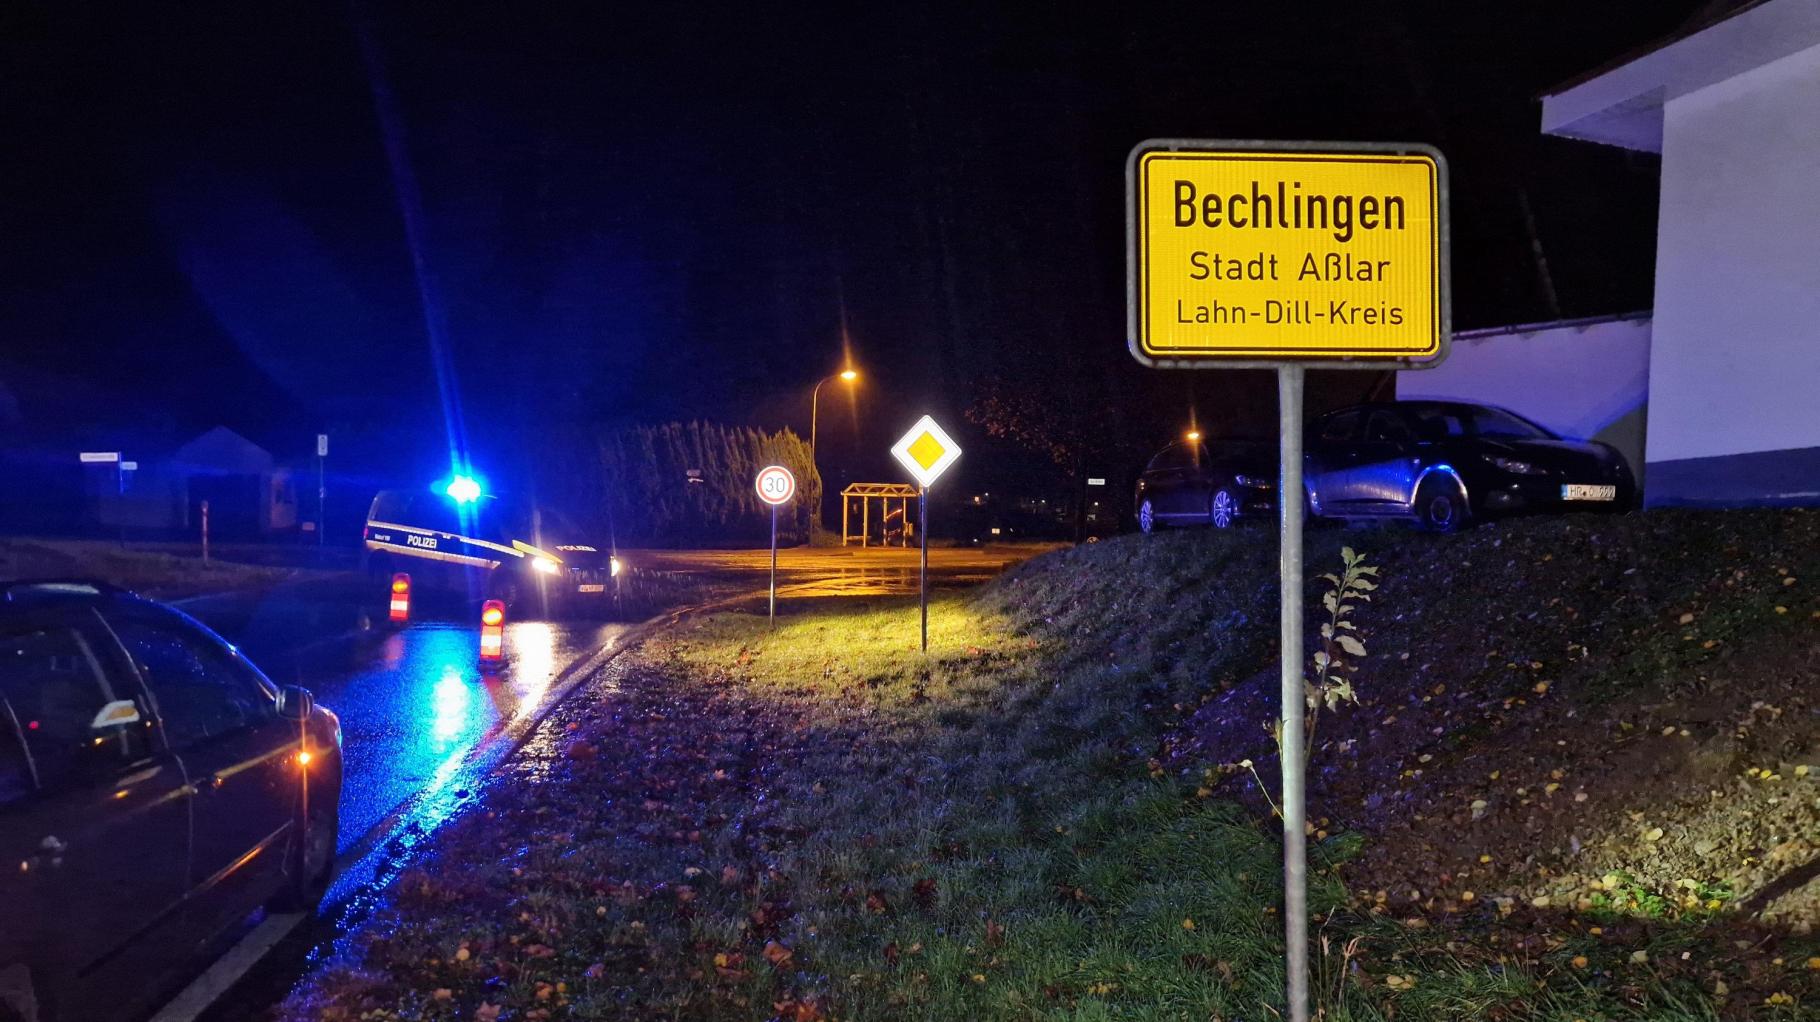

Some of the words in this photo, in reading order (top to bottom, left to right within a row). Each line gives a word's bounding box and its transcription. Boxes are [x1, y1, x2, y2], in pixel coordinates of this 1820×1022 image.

[1174, 179, 1405, 243] Bechlingen
[1190, 251, 1279, 281] Stadt
[1298, 252, 1391, 282] Aßlar
[1177, 299, 1404, 325] Lahn-Dill-Kreis
[765, 476, 786, 493] 30
[407, 534, 438, 549] POLIZEI
